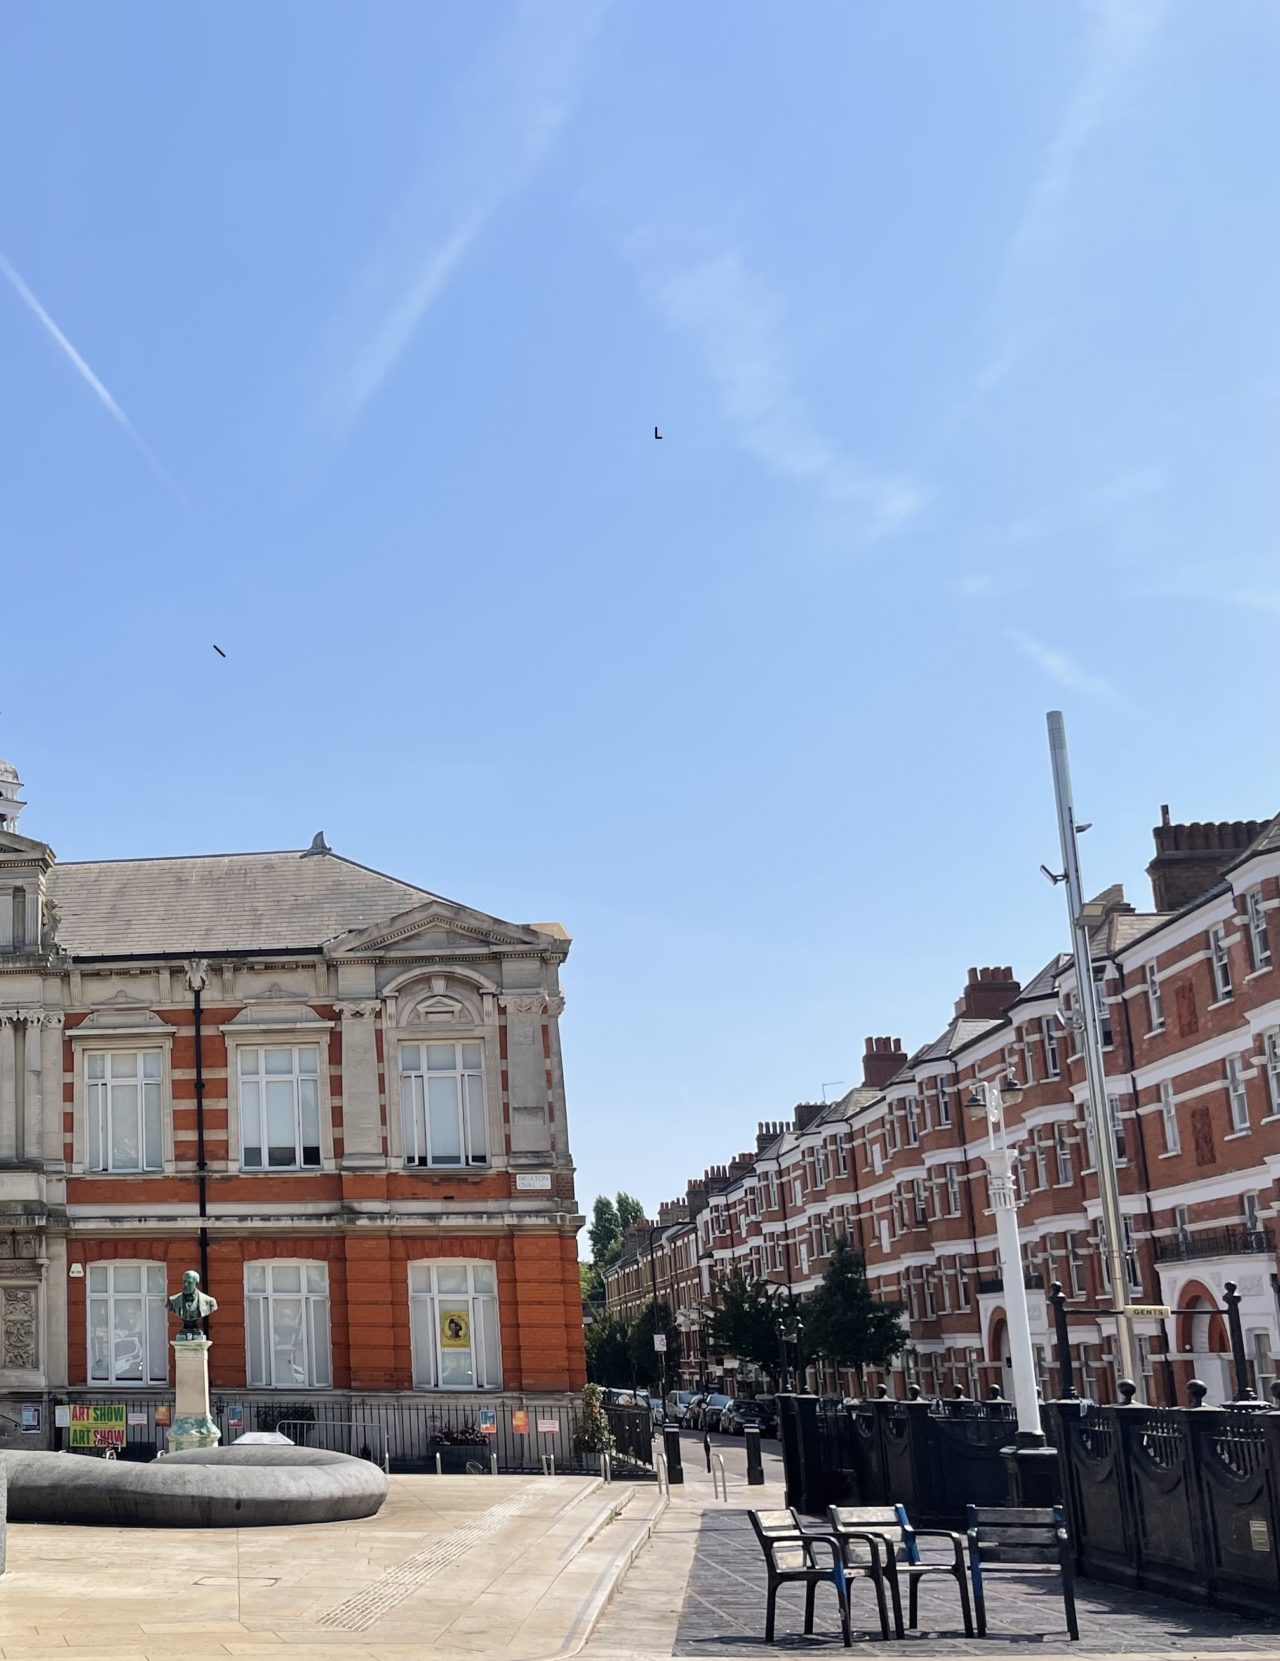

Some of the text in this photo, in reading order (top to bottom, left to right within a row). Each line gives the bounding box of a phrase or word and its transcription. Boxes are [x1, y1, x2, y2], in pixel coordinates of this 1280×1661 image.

[1134, 1308, 1163, 1316] GENTS
[72, 1406, 91, 1422] ART
[93, 1406, 124, 1422] SHOW
[72, 1429, 124, 1446] ART SHOW
